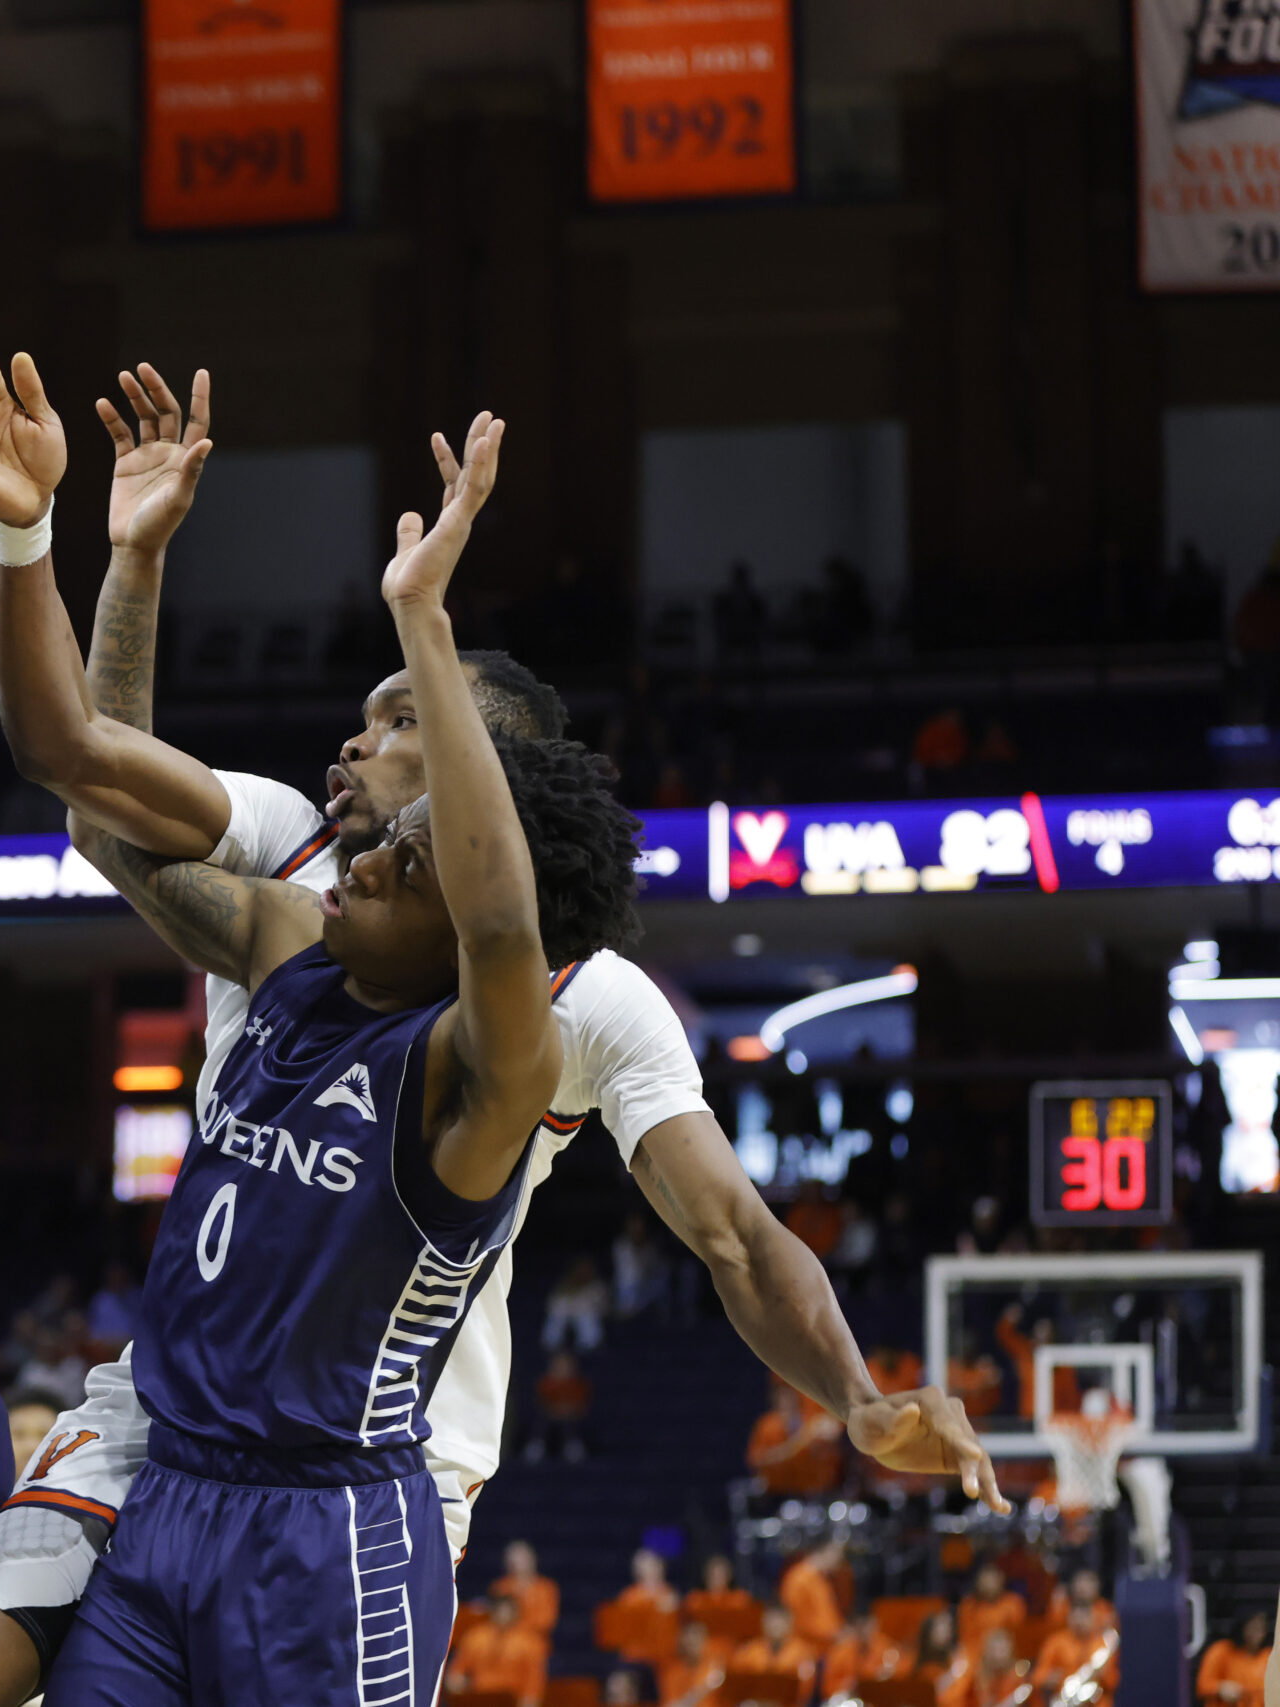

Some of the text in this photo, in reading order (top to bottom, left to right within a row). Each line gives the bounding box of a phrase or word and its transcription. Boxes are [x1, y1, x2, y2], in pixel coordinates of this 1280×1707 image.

[175, 125, 310, 193] 1991
[619, 96, 767, 164] 1992
[1060, 1135, 1147, 1212] 30
[196, 1182, 238, 1283] 0
